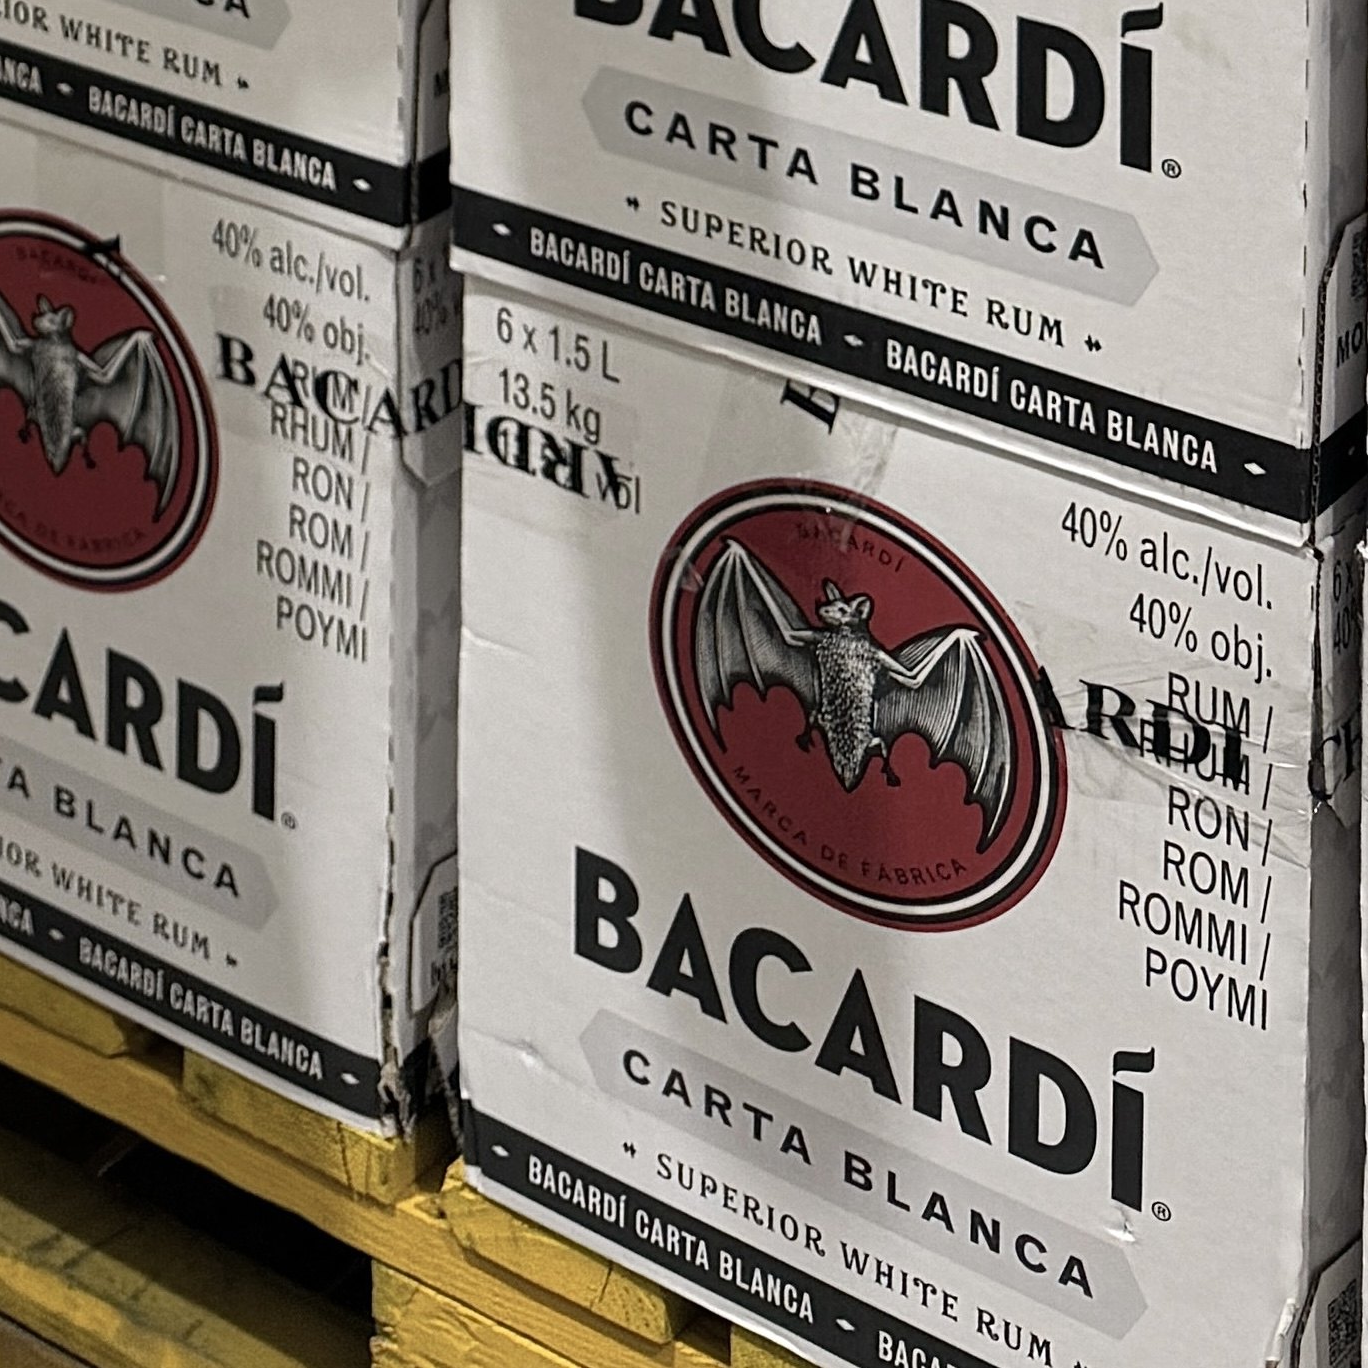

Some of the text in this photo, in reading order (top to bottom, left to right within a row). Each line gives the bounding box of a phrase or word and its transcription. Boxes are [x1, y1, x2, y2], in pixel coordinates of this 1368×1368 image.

[59, 14, 152, 66] WHITE
[163, 45, 222, 89] RUM
[88, 85, 177, 138] BACARDÍ
[181, 111, 246, 163] CARTA
[253, 137, 337, 193] BLANCA
[623, 100, 1106, 270] CARTA BLANCA
[212, 218, 262, 268] 40%
[270, 239, 370, 302] alc./vol.
[661, 200, 1065, 349] SUPERIOR WHITE RUM
[263, 293, 371, 366] 40% obj.
[497, 307, 620, 384] 6 x 1.5 L
[528, 225, 1218, 474] BACARDÍ CARTA BLANCA BACARDÍ CARTA BLANCA
[271, 402, 353, 462] RHUM
[499, 368, 601, 445] 13.5 kg
[292, 458, 353, 512] RON
[256, 539, 353, 610] ROMMI
[289, 503, 353, 559] ROM
[1061, 500, 1128, 564] 40%
[1139, 528, 1272, 611] alc./vol.
[276, 595, 367, 663] POYMI
[1129, 591, 1273, 683] 40% obj.
[54, 785, 239, 899] BLANCA
[1169, 785, 1248, 851] RON
[51, 862, 140, 927] WHITE
[152, 911, 211, 961] RUM
[1164, 840, 1248, 909] ROM
[1118, 879, 1249, 969] ROMMI
[78, 937, 164, 999] BACARDÍ
[169, 979, 235, 1038] CARTA
[239, 1015, 322, 1080] BLANCA
[573, 843, 1156, 1212] BACARDÍ
[1145, 947, 1268, 1031] POYMI
[621, 1048, 1095, 1300] CARTA BLANCA
[528, 1154, 814, 1324] BACARDÍ CARTA BLANCA
[655, 1152, 1054, 1368] SUPERIOR WHITE RUM
